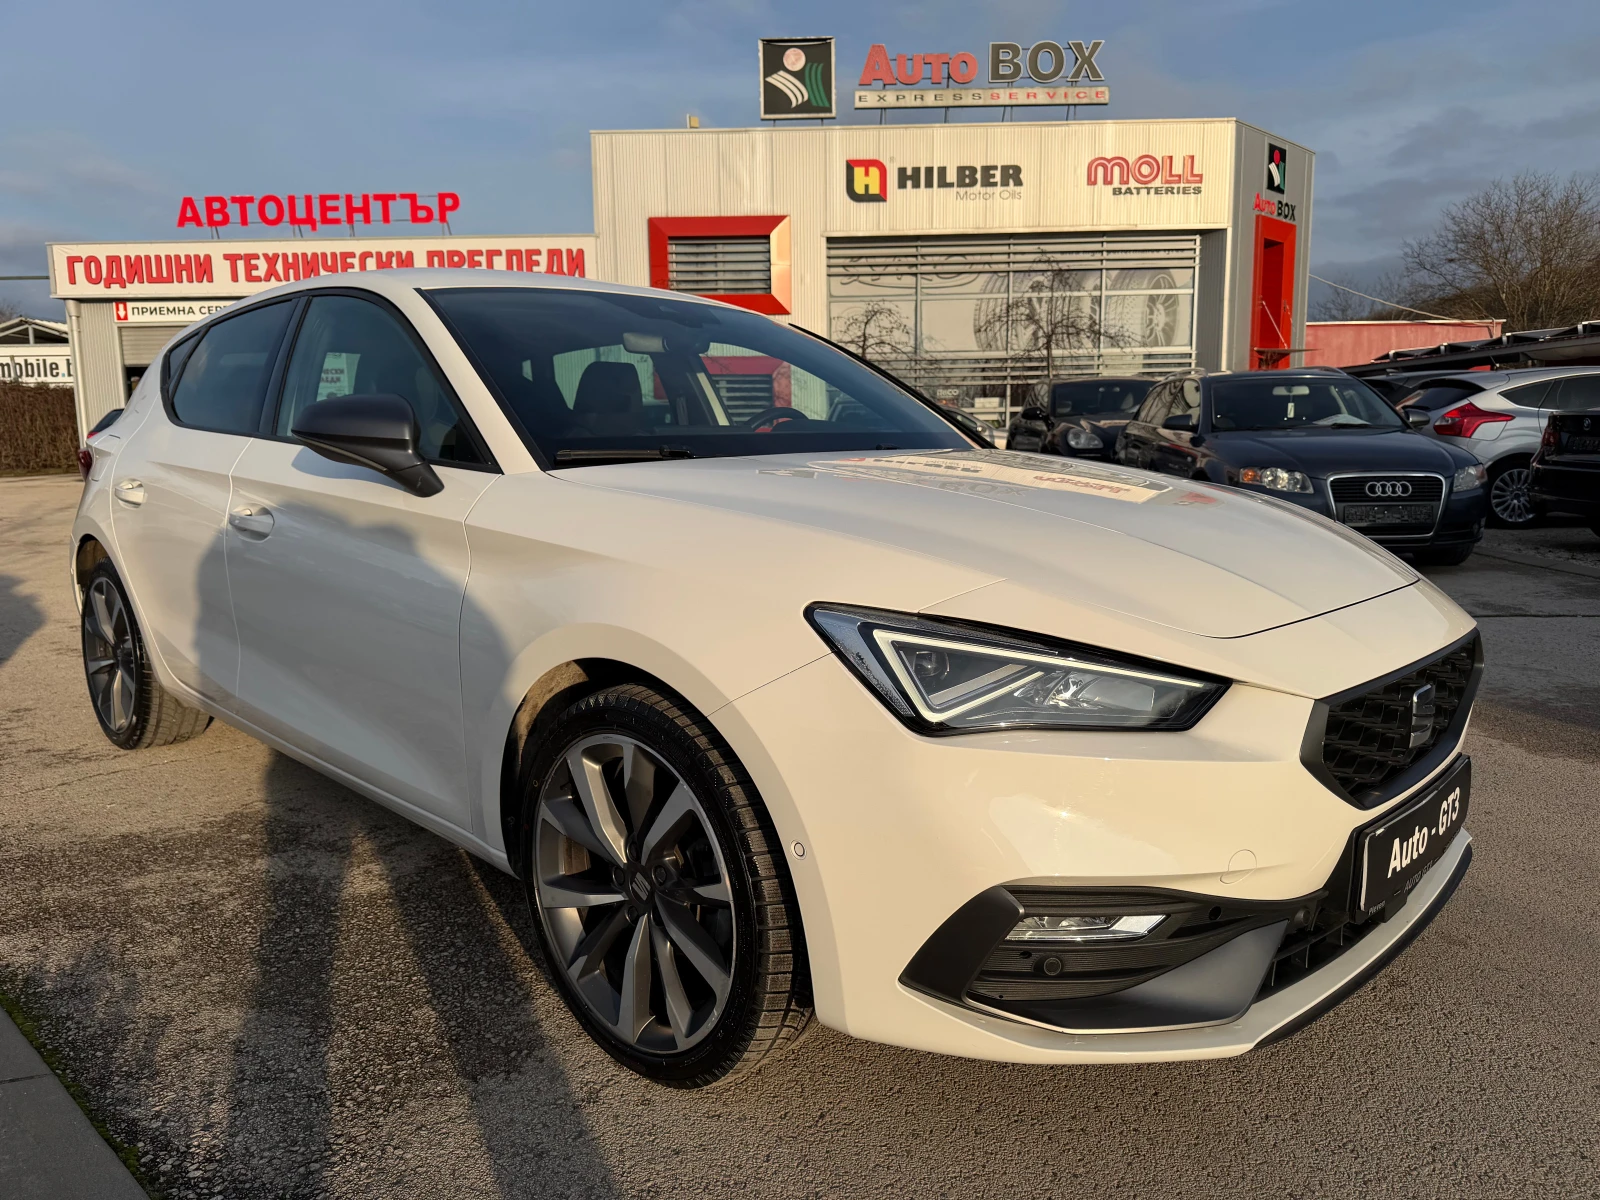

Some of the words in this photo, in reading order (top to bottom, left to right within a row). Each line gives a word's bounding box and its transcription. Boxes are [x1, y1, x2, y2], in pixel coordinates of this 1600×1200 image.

[988, 39, 1106, 84] BOX
[897, 164, 1024, 190] HILBER
[955, 190, 995, 201] Motor
[999, 189, 1022, 201] Oils
[1112, 186, 1203, 196] BATTERIES
[176, 191, 461, 232] АВТОЦЕНТЪР
[1277, 199, 1297, 222] BOX
[66, 253, 214, 289] ГОДИШНИ
[131, 305, 196, 317] ПРИЕМНА
[1387, 825, 1428, 879] Auto
[1438, 786, 1461, 836] GT3
